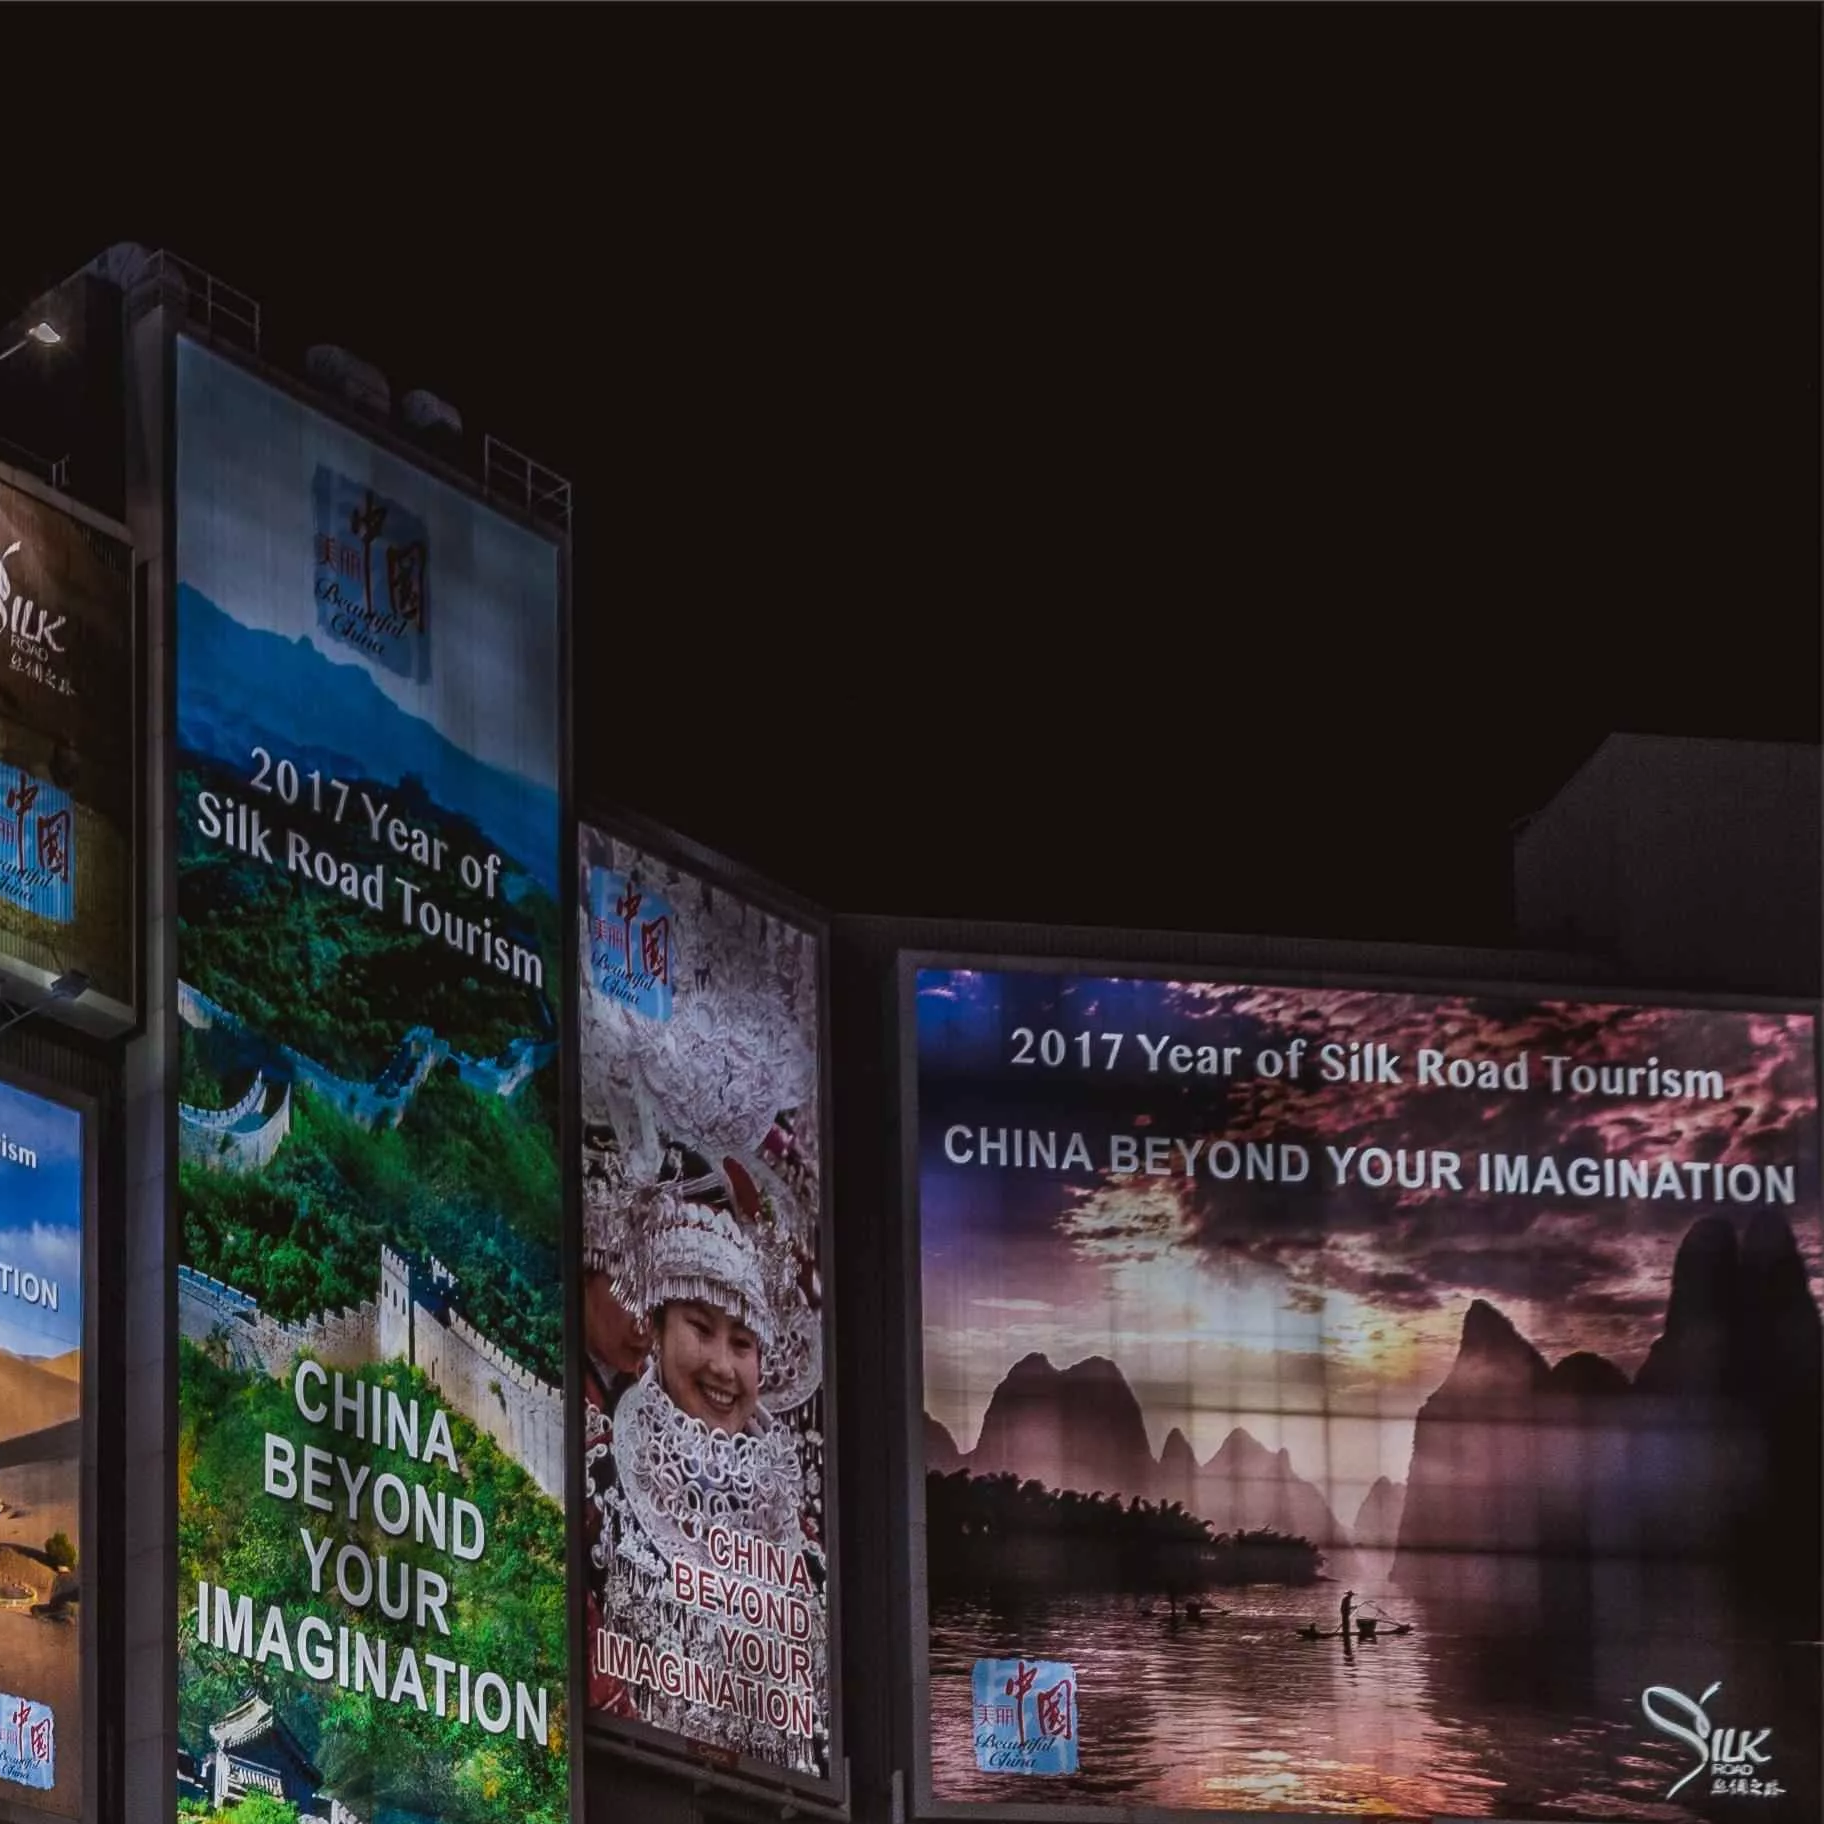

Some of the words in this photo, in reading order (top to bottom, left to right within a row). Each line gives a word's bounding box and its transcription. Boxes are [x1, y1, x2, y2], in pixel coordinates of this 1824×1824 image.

[250, 746, 349, 823] 2017
[361, 792, 449, 873] Year
[461, 850, 502, 899] of
[197, 790, 273, 865] Silk
[287, 831, 384, 912] Road
[394, 876, 544, 990] Tourism
[1010, 1027, 1124, 1070] 2017
[1136, 1034, 1243, 1077] Year
[1256, 1039, 1308, 1079] of
[1320, 1042, 1403, 1085] Silk
[1417, 1048, 1529, 1091] Road
[1542, 1056, 1725, 1099] Tourism
[944, 1124, 1094, 1173] CHINA
[1110, 1134, 1310, 1183] BEYOND
[1325, 1146, 1463, 1190] YOUR
[1479, 1152, 1795, 1206] IMAGINATION
[294, 1359, 459, 1473] CHINA
[264, 1432, 486, 1561] BEYOND
[300, 1527, 450, 1635] YOUR
[674, 1559, 813, 1642] BEYOND
[708, 1526, 813, 1597] CHINA
[198, 1581, 548, 1746] IMAGINATION
[596, 1628, 814, 1738] IMAGINATION
[718, 1624, 813, 1689] YOUR
[975, 1733, 1057, 1754] Beautiful
[989, 1751, 1038, 1769] China
[1711, 1763, 1754, 1776] ROAD
